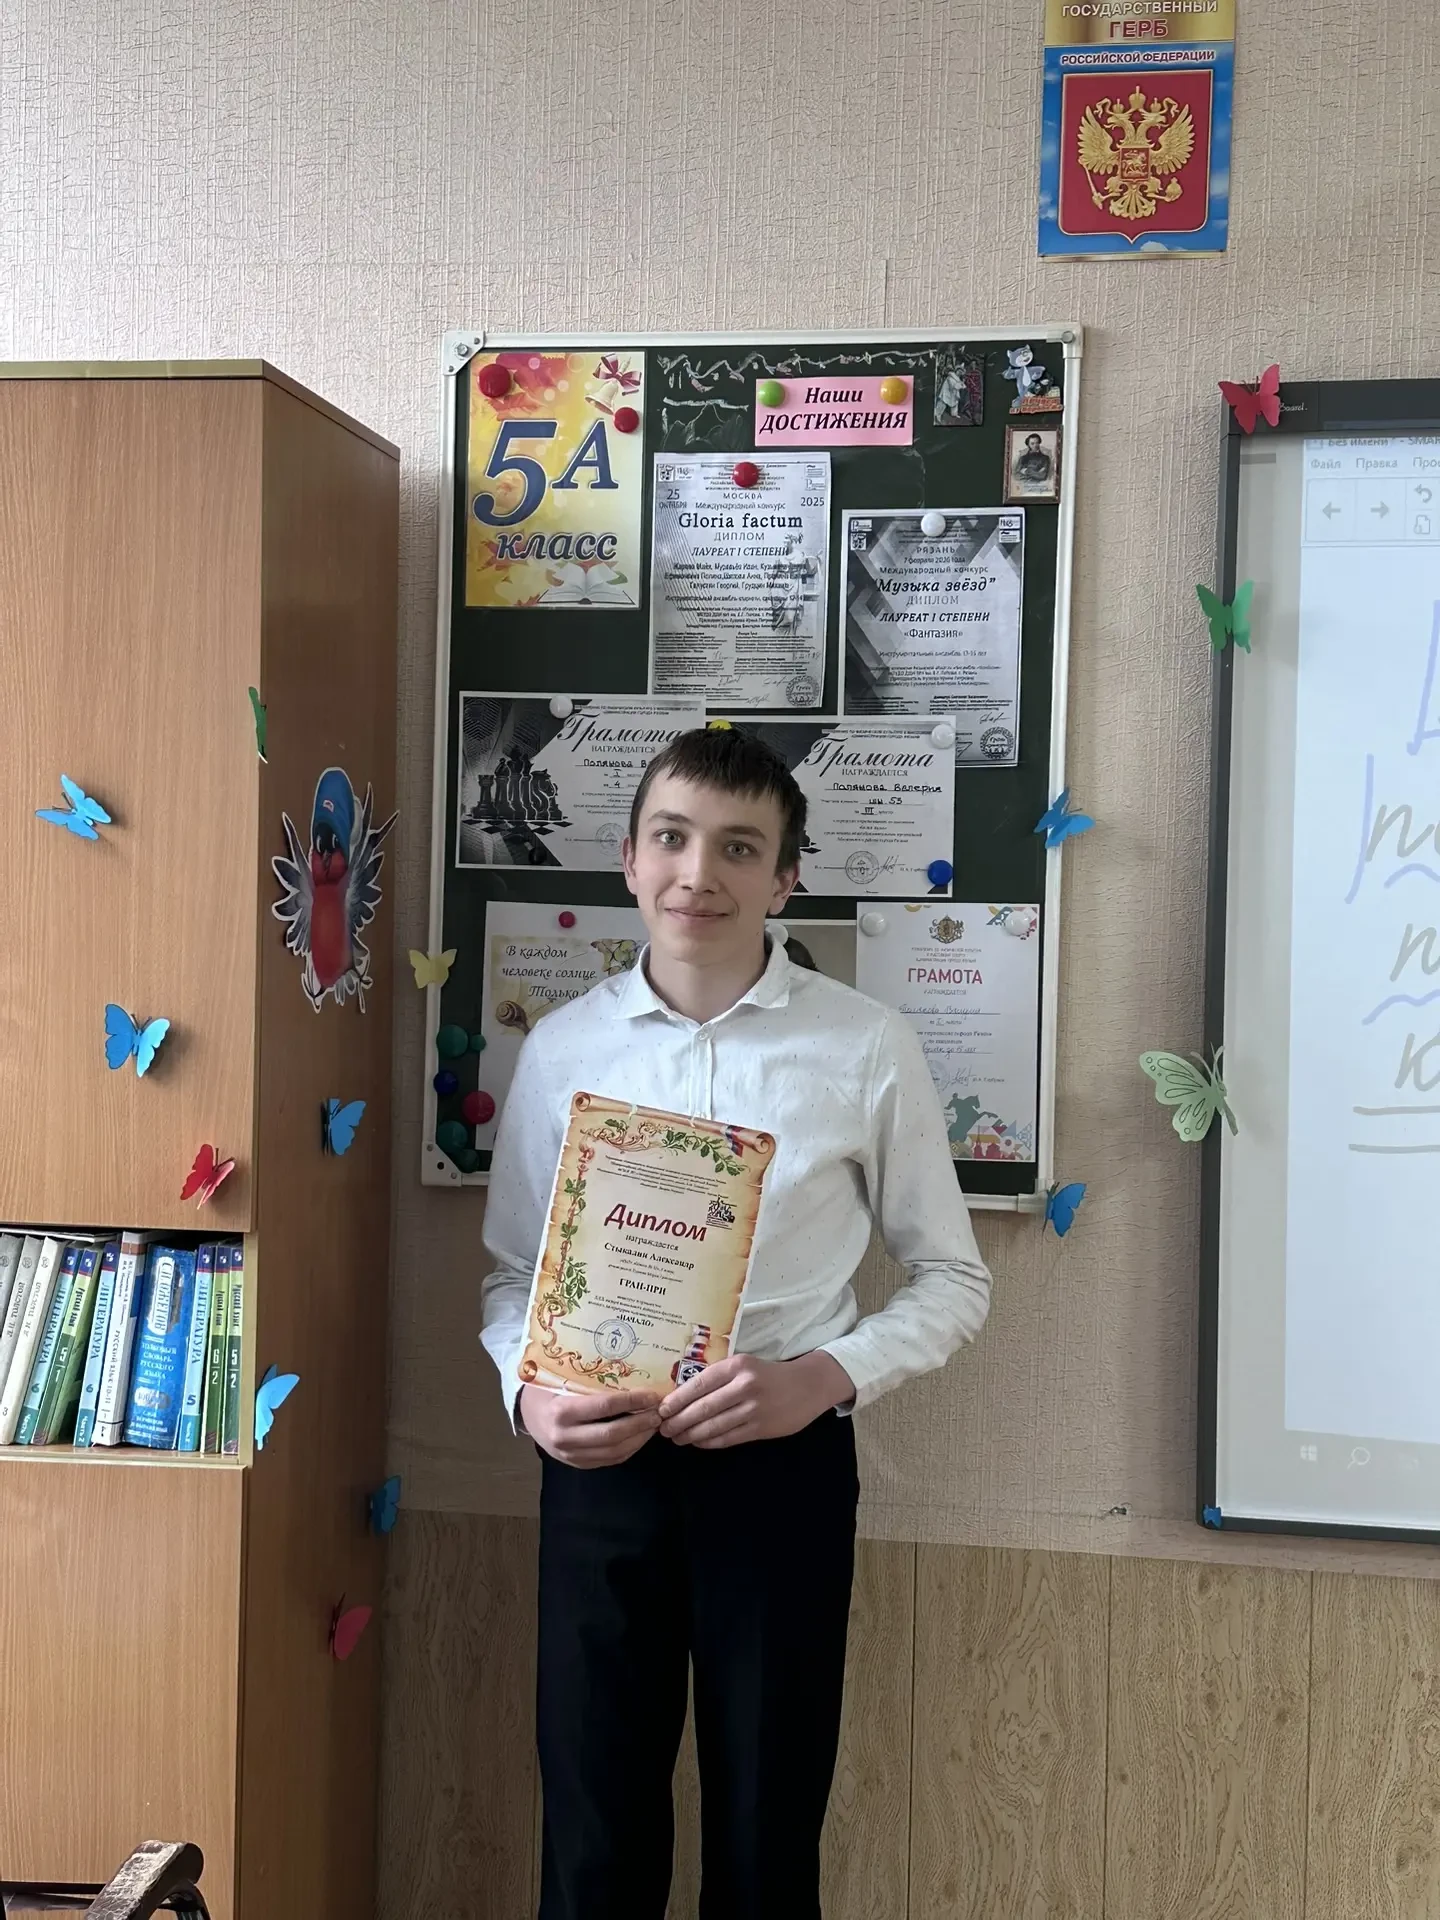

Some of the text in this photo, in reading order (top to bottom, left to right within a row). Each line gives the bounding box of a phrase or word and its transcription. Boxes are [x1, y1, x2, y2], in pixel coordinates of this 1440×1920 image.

[1062, 0, 1218, 17] ГОСУДАРСТВЕННЫЙ
[1110, 19, 1168, 38] ГЕРБ
[1061, 50, 1216, 65] РОССИЙСКОЙ ФЕДЕРАЦИИ
[804, 386, 864, 406] Наши
[759, 411, 908, 434] ДОСТИЖЕНИЯ
[1310, 458, 1342, 470] Файл
[1356, 457, 1399, 470] Правка
[666, 488, 680, 500] 25
[722, 492, 763, 500] МОСКВА
[800, 496, 825, 507] 2025
[678, 512, 804, 529] Gloria factum
[714, 532, 765, 542] ДИПЛОМ
[496, 531, 618, 561] класс
[690, 547, 737, 557] ЛАУРЕАТ
[743, 547, 789, 557] СТЕПЕНИ
[879, 566, 989, 576] Международный конкурс
[906, 595, 959, 607] ДИПЛОМ
[880, 612, 930, 623] ЛАУРЕАТ
[938, 611, 991, 623] СТЕПЕНИ
[804, 737, 934, 777] Грамота
[505, 944, 568, 959] В каждом
[502, 967, 552, 980] человеке
[907, 967, 983, 985] ГРАМОТА
[528, 985, 579, 999] Только
[603, 1203, 708, 1242] Диплом
[649, 1253, 696, 1270] Александр
[90, 1282, 111, 1360] ЛИТЕРАТУРА
[191, 1279, 209, 1364] ЛИТЕРАТУРА
[60, 1346, 69, 1362] 5
[213, 1350, 220, 1364] 6
[231, 1348, 238, 1365] 5
[211, 1370, 219, 1385] 2
[230, 1373, 237, 1389] 2
[31, 1383, 41, 1394] 6
[85, 1383, 94, 1393] 6
[186, 1394, 197, 1406] 5
